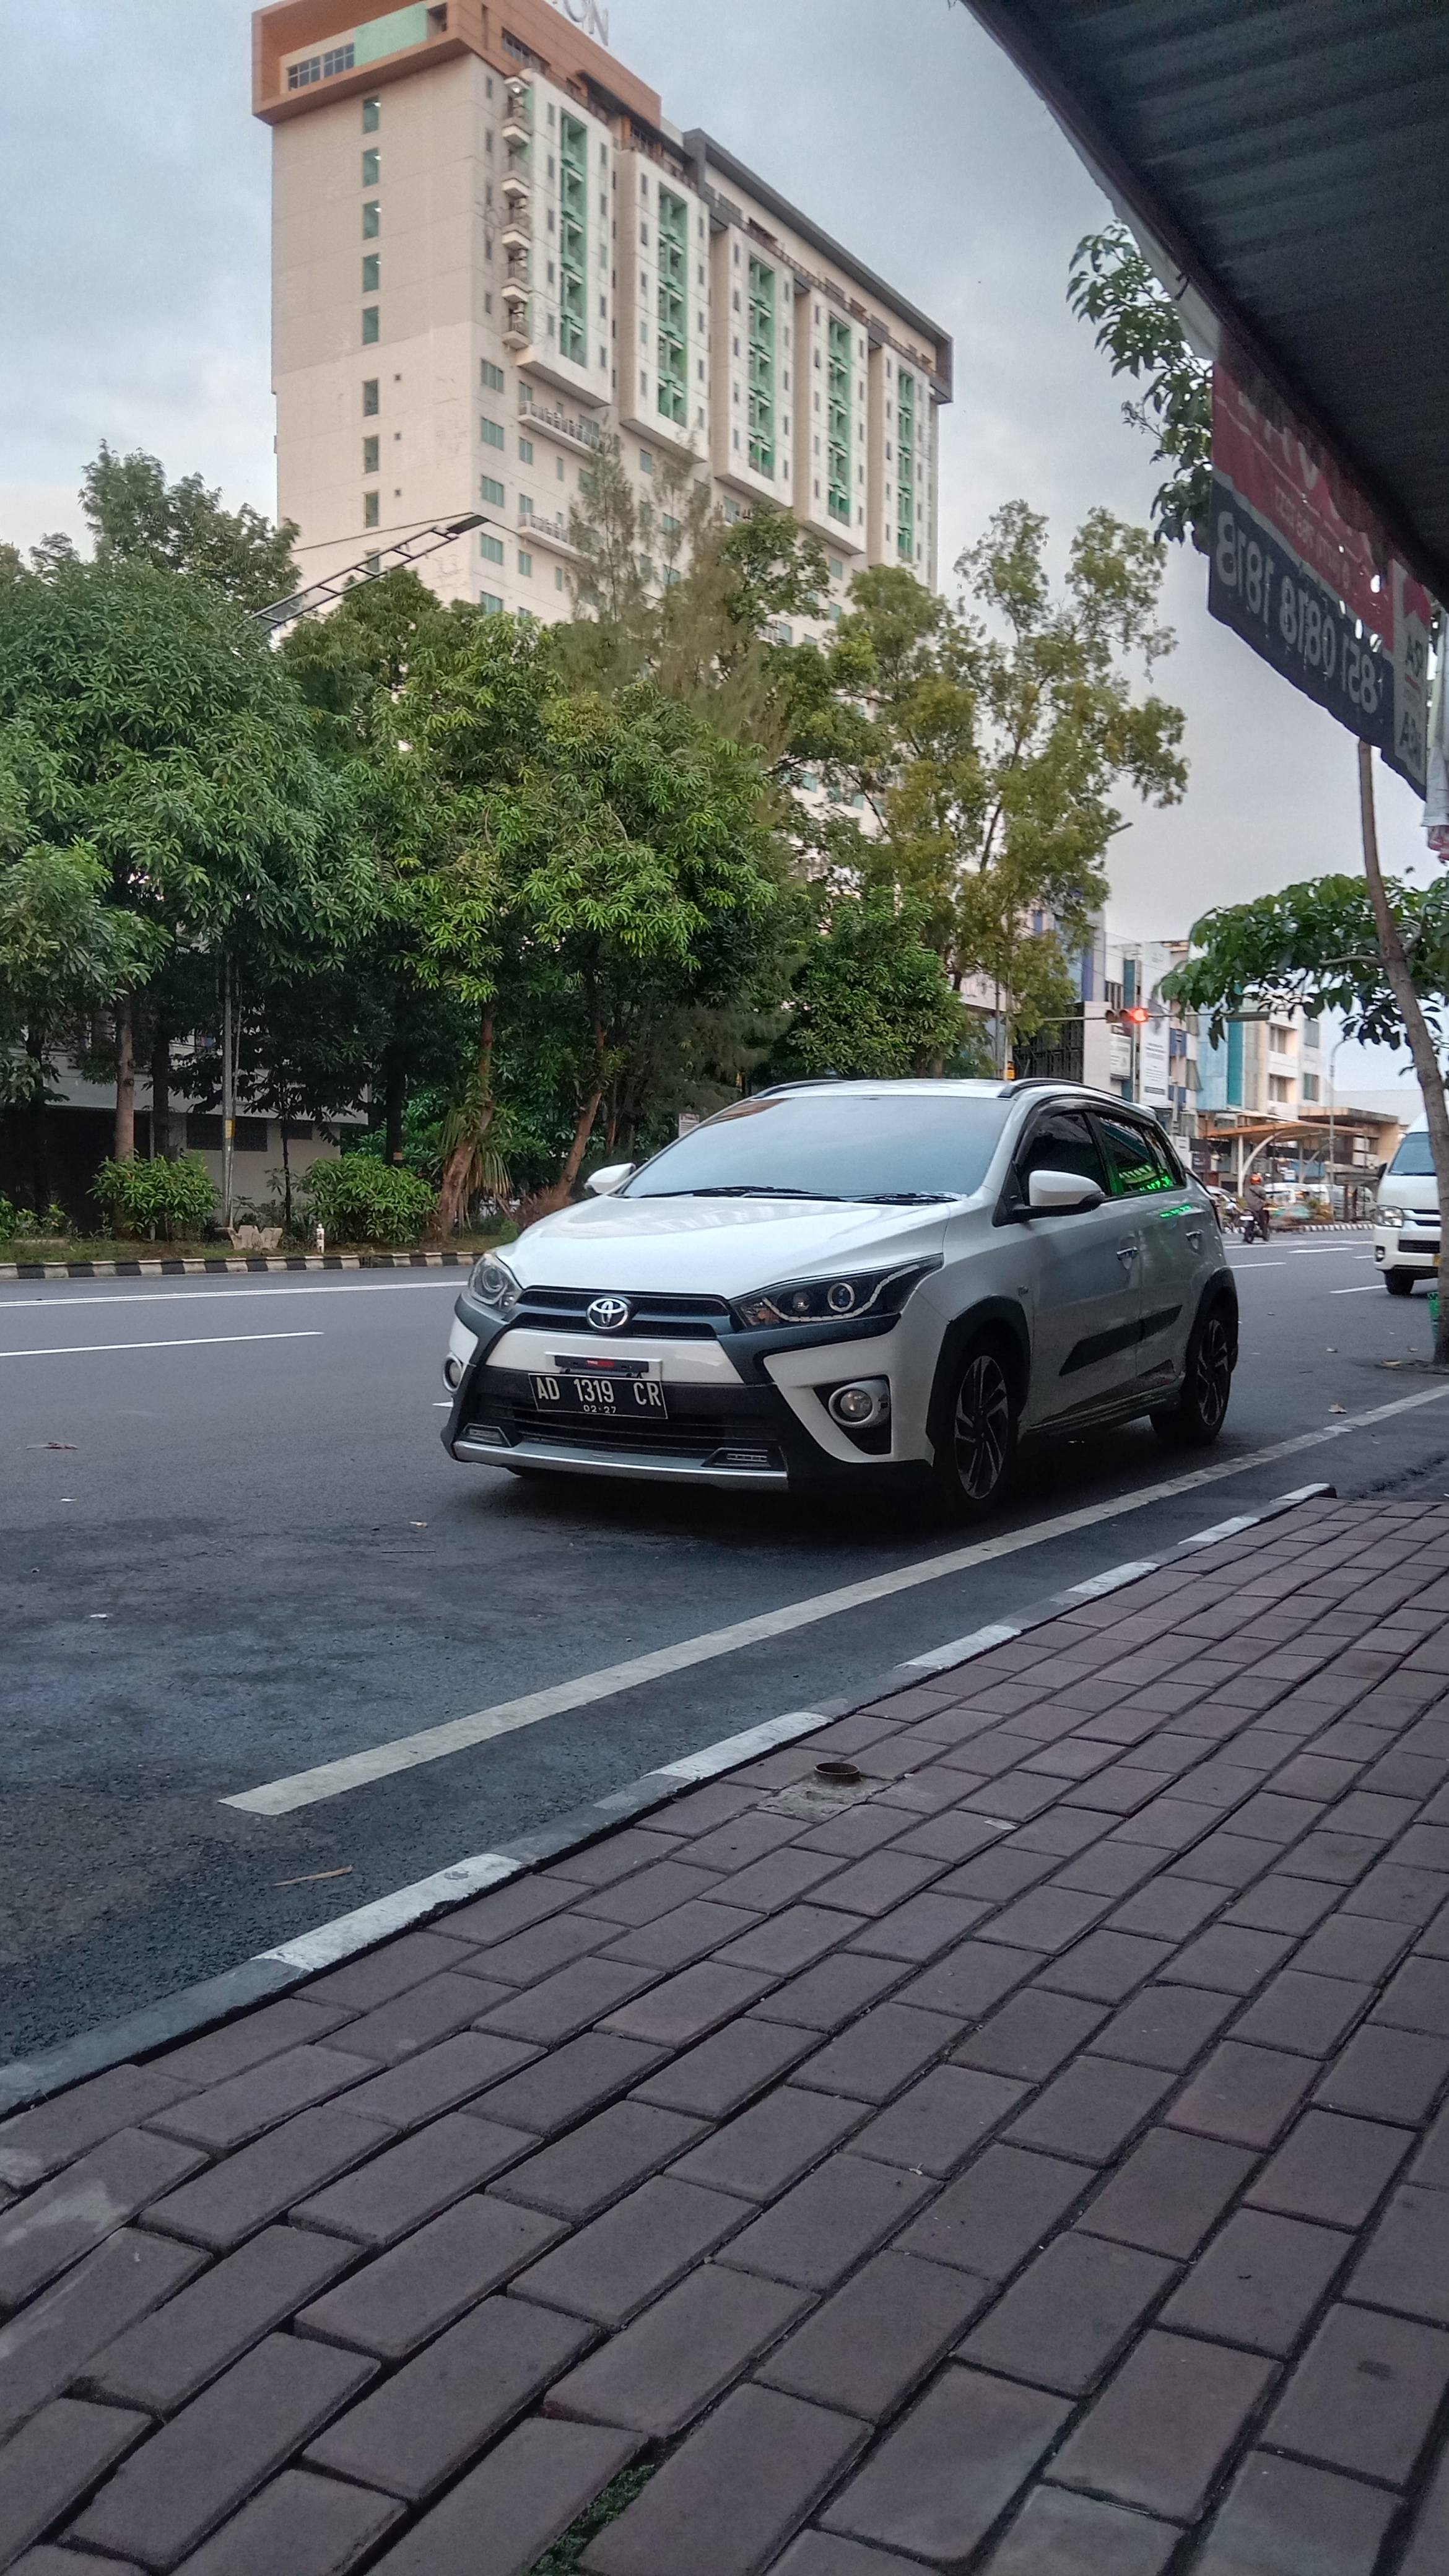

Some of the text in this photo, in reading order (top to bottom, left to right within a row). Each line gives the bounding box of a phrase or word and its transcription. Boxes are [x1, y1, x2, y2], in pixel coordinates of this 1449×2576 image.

[536, 1377, 662, 1406] AD 1319 CR
